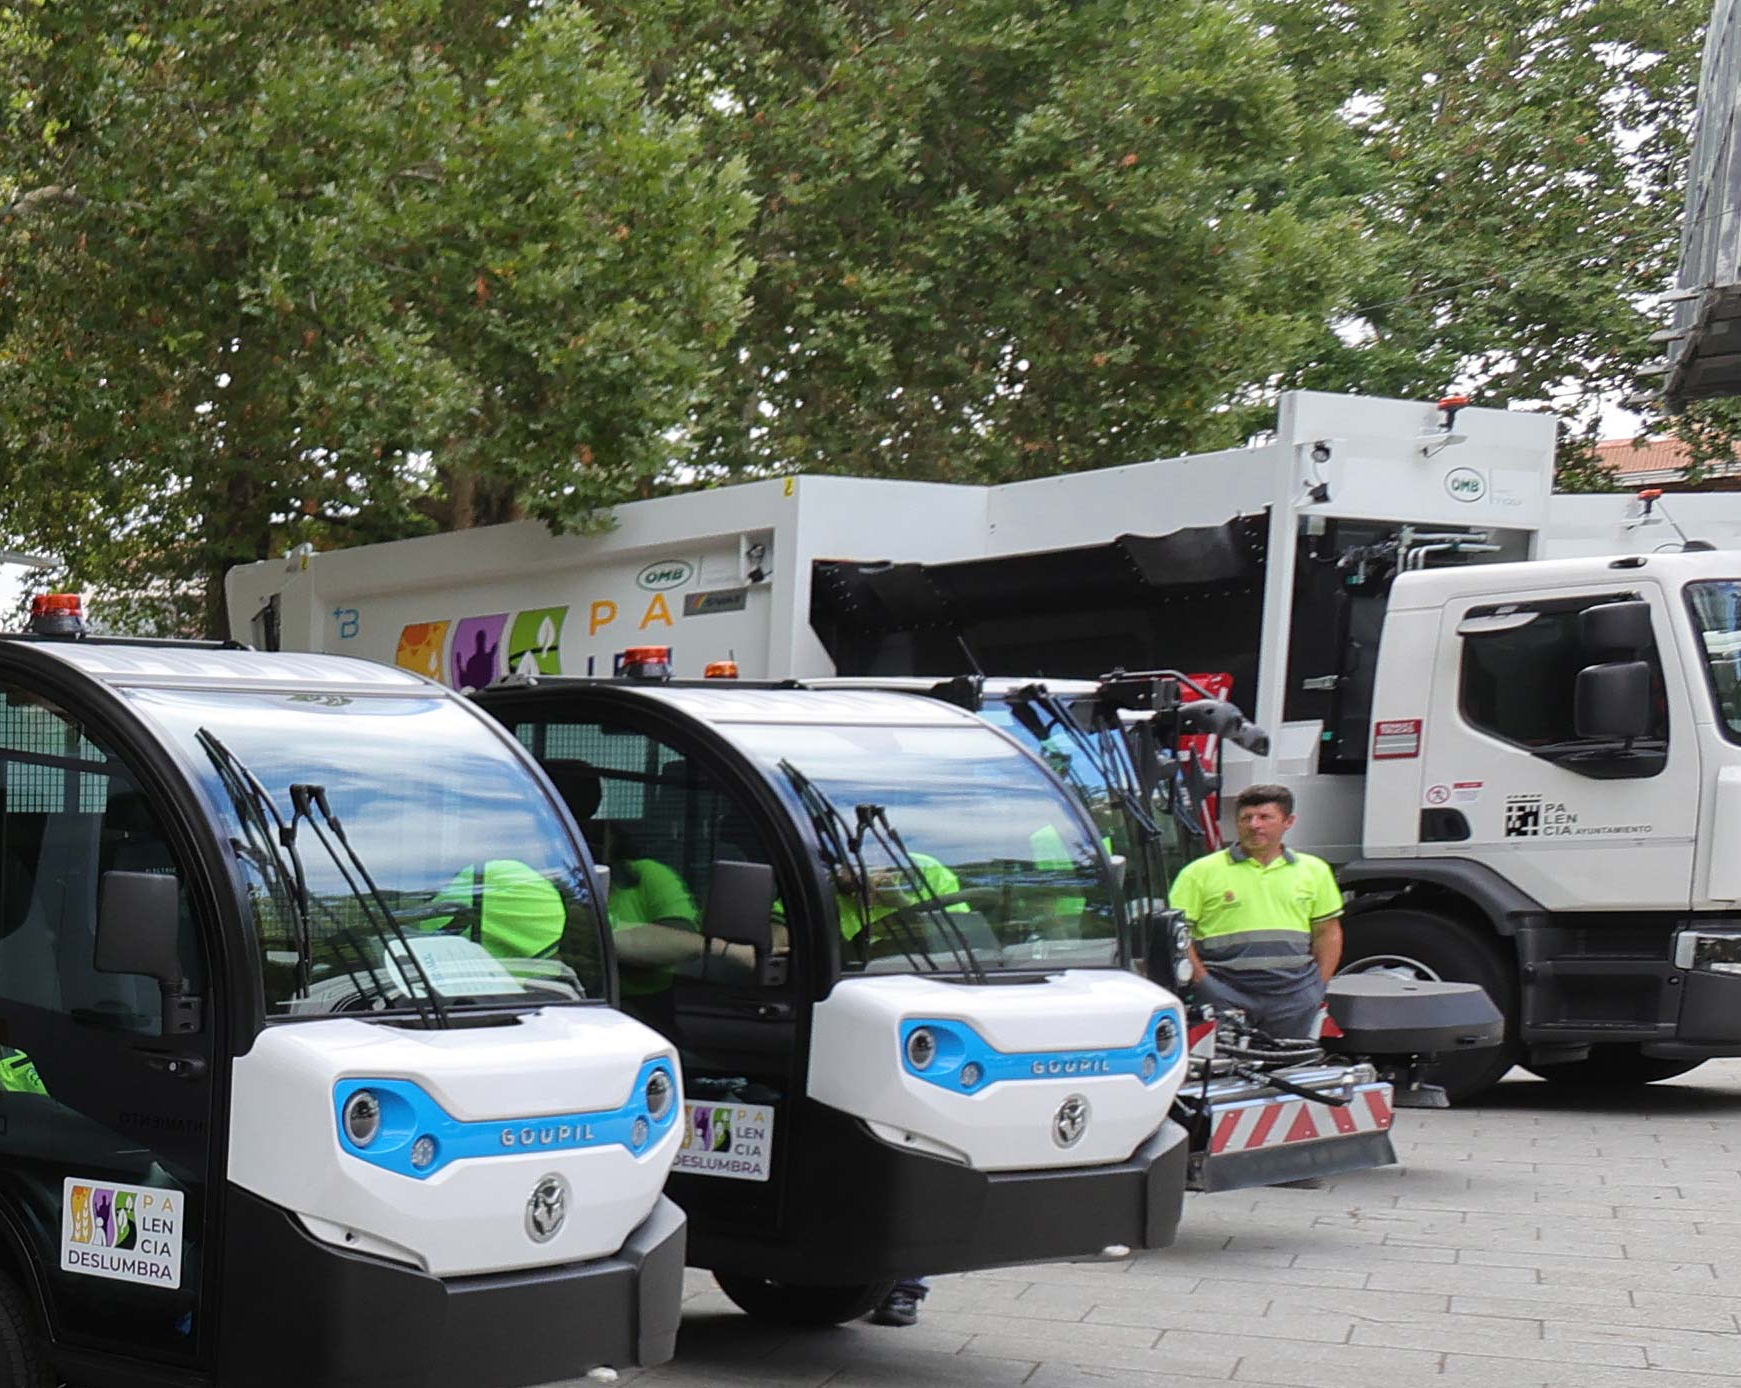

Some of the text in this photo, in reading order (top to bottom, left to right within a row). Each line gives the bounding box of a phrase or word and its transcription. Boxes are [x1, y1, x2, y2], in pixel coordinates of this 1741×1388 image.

[644, 567, 685, 583] OMB
[1545, 803, 1565, 813] PA
[1544, 814, 1578, 825] LEN
[1543, 825, 1653, 836] CIA AYUNTAMIENTO
[1031, 1059, 1110, 1075] GOUPIL
[501, 1124, 595, 1147] GOUPIL
[736, 1126, 765, 1140] LEN
[734, 1144, 762, 1157] CIA
[142, 1216, 174, 1235] LEN
[141, 1239, 172, 1258] CIA
[68, 1249, 173, 1281] DESLUMBRA
